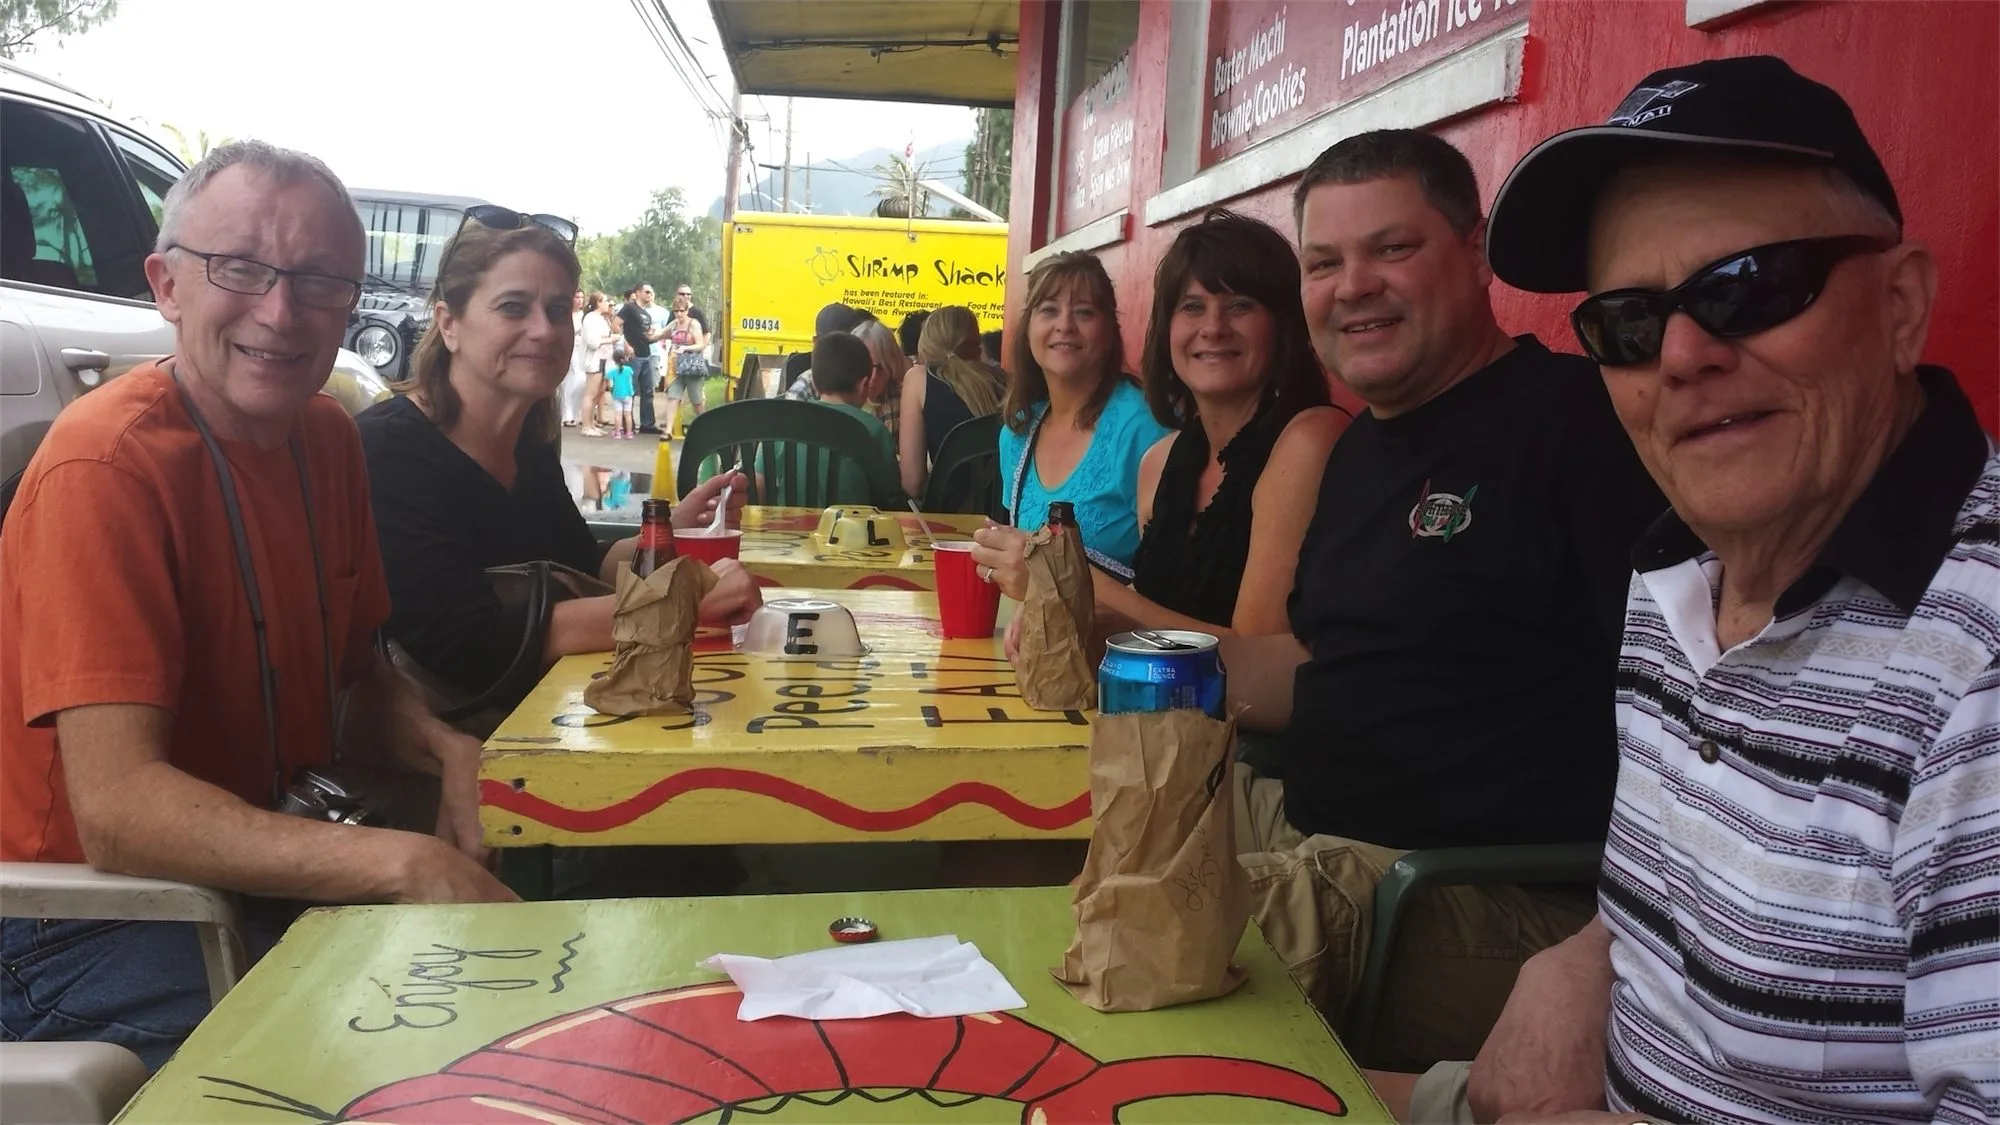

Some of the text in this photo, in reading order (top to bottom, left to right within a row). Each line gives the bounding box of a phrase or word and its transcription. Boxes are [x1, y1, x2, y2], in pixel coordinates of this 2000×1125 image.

[1214, 4, 1287, 98] Butter Mochi
[1341, 0, 1440, 80] Plantation
[1211, 62, 1306, 150] Brownie/Cookies
[742, 318, 779, 331] 009434
[842, 297, 876, 306] Hawaii's
[878, 299, 896, 307] Best
[967, 301, 988, 310] Food
[844, 289, 929, 300] has been featured in:
[784, 613, 820, 655] E
[348, 943, 542, 1032] Enjoy
